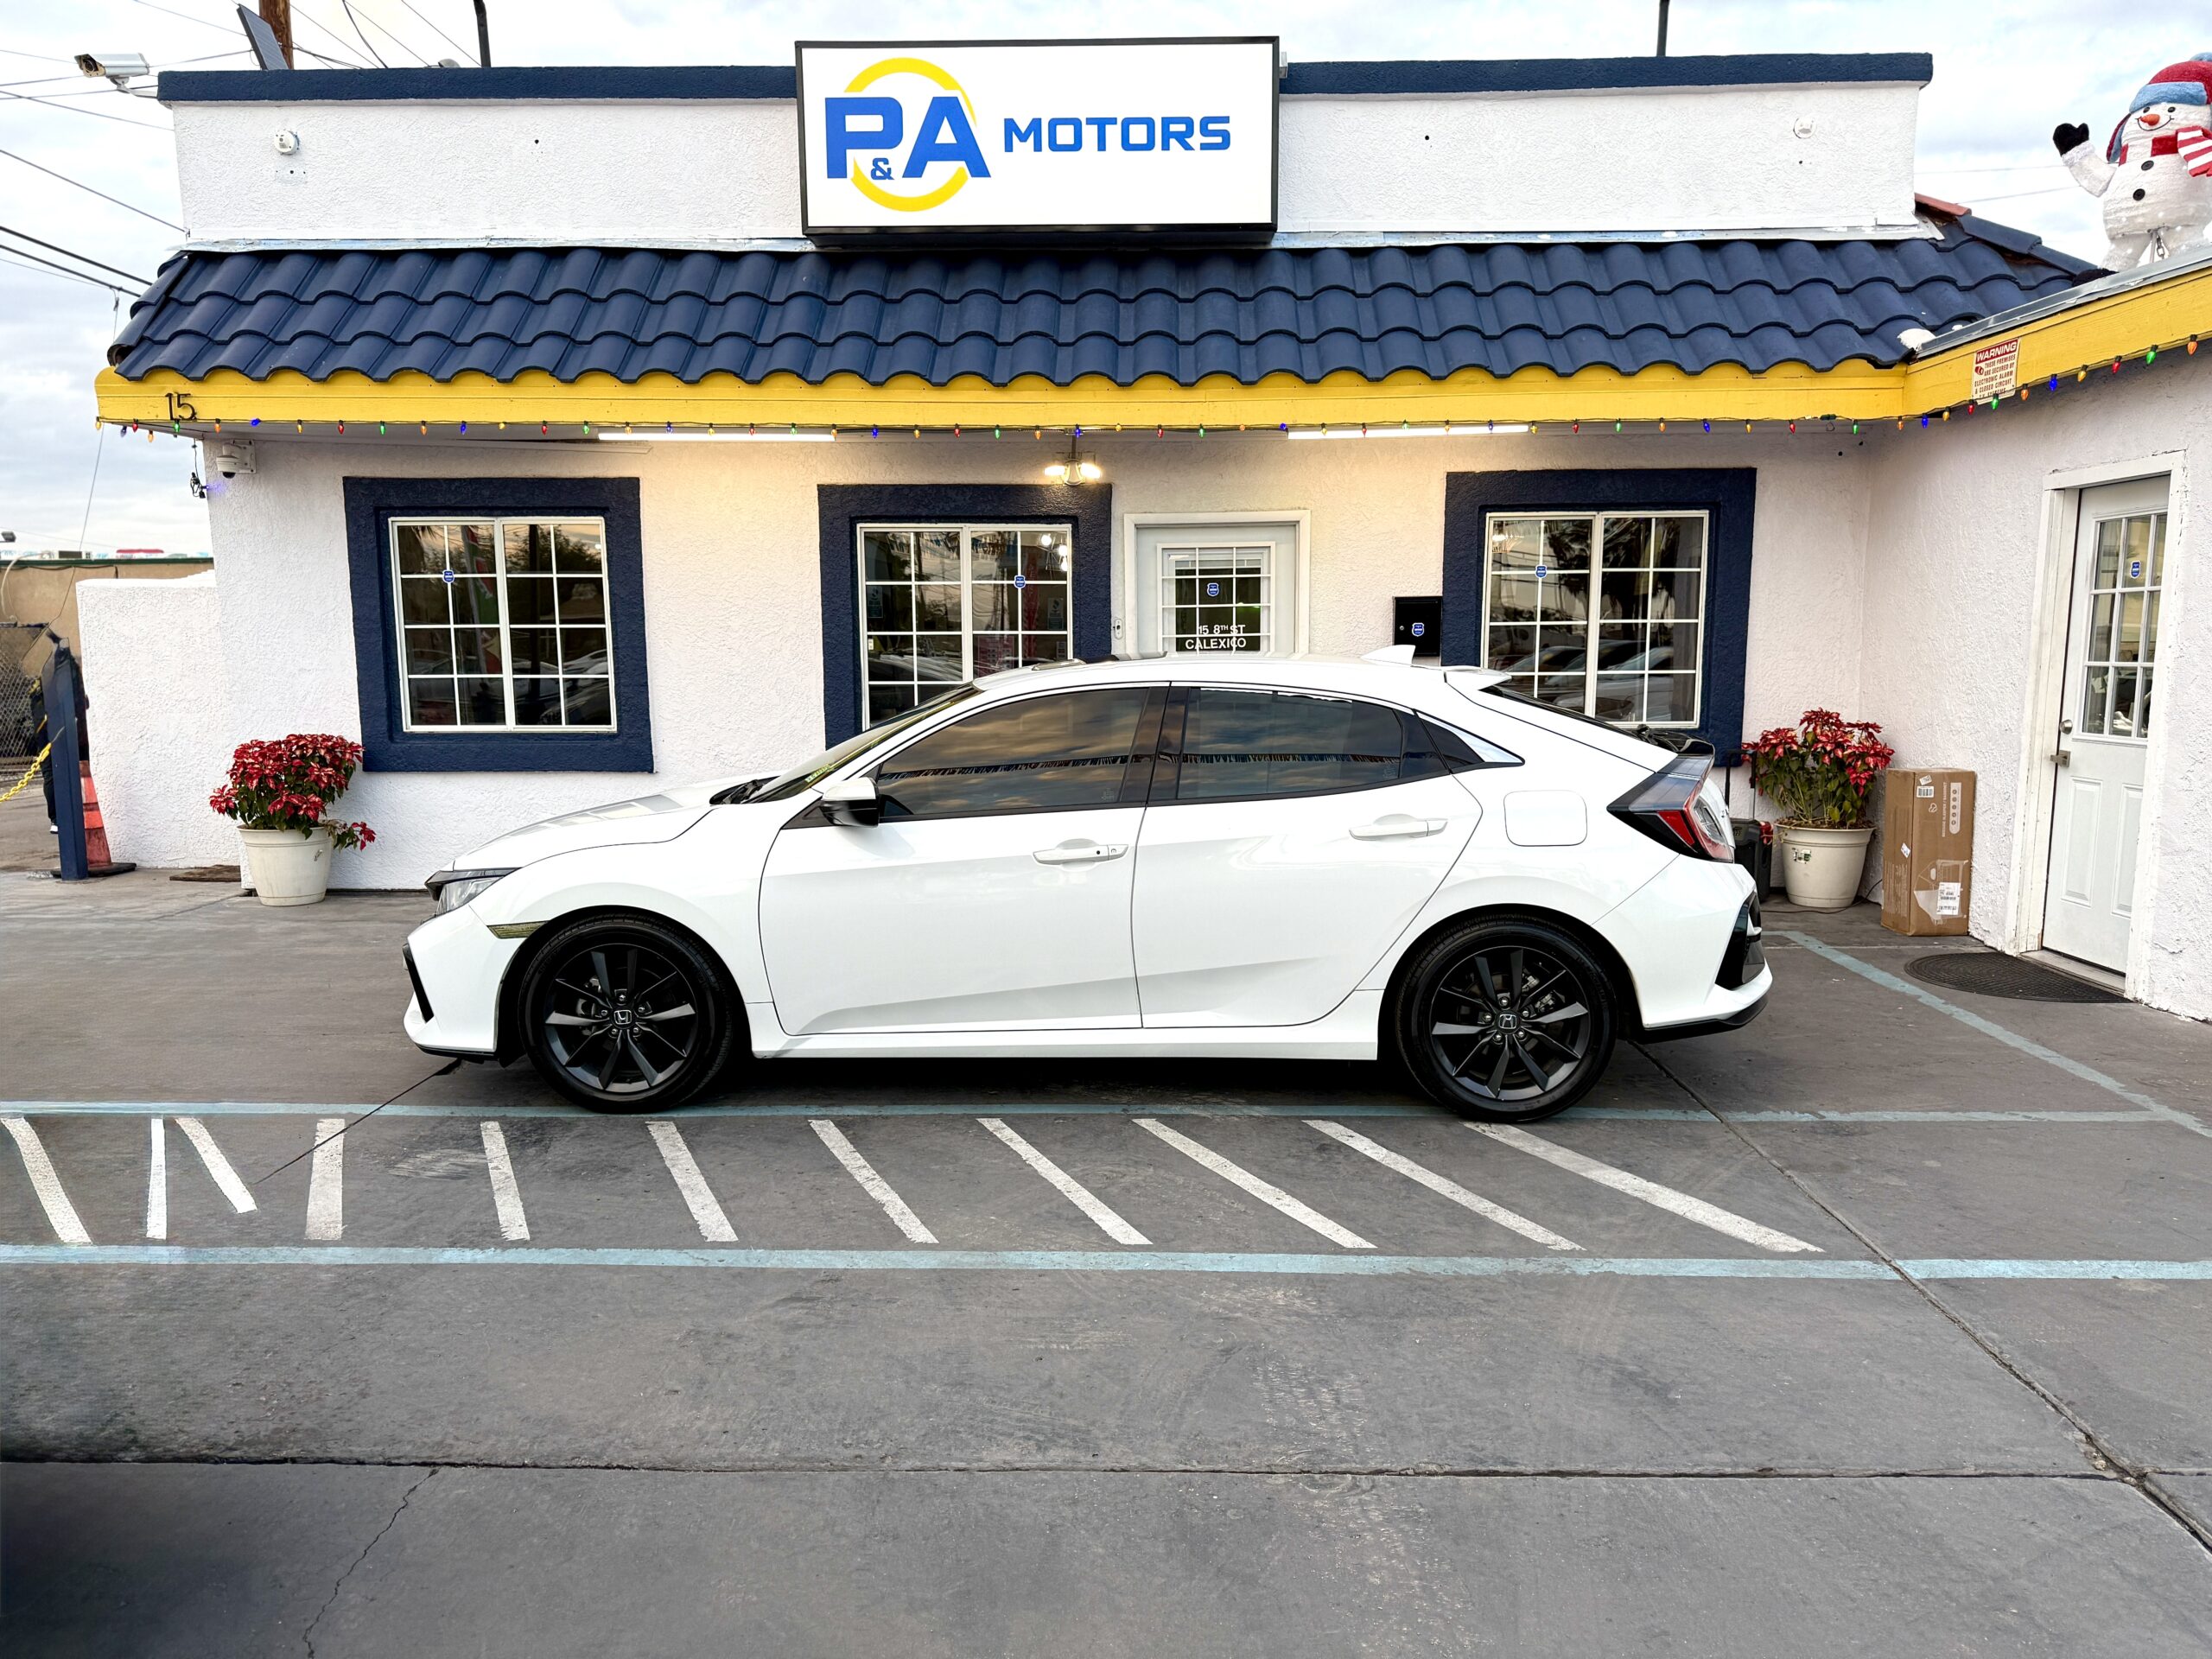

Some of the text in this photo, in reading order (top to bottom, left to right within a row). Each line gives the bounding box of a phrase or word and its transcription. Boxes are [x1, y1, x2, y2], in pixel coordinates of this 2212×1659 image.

[824, 96, 1231, 181] P&A MOTORS
[1977, 341, 2017, 363] WARNING
[1985, 360, 1996, 369] THESE
[1999, 370, 2013, 379] ALARM
[165, 392, 198, 421] 15
[1185, 637, 1246, 649] CALEXICO
